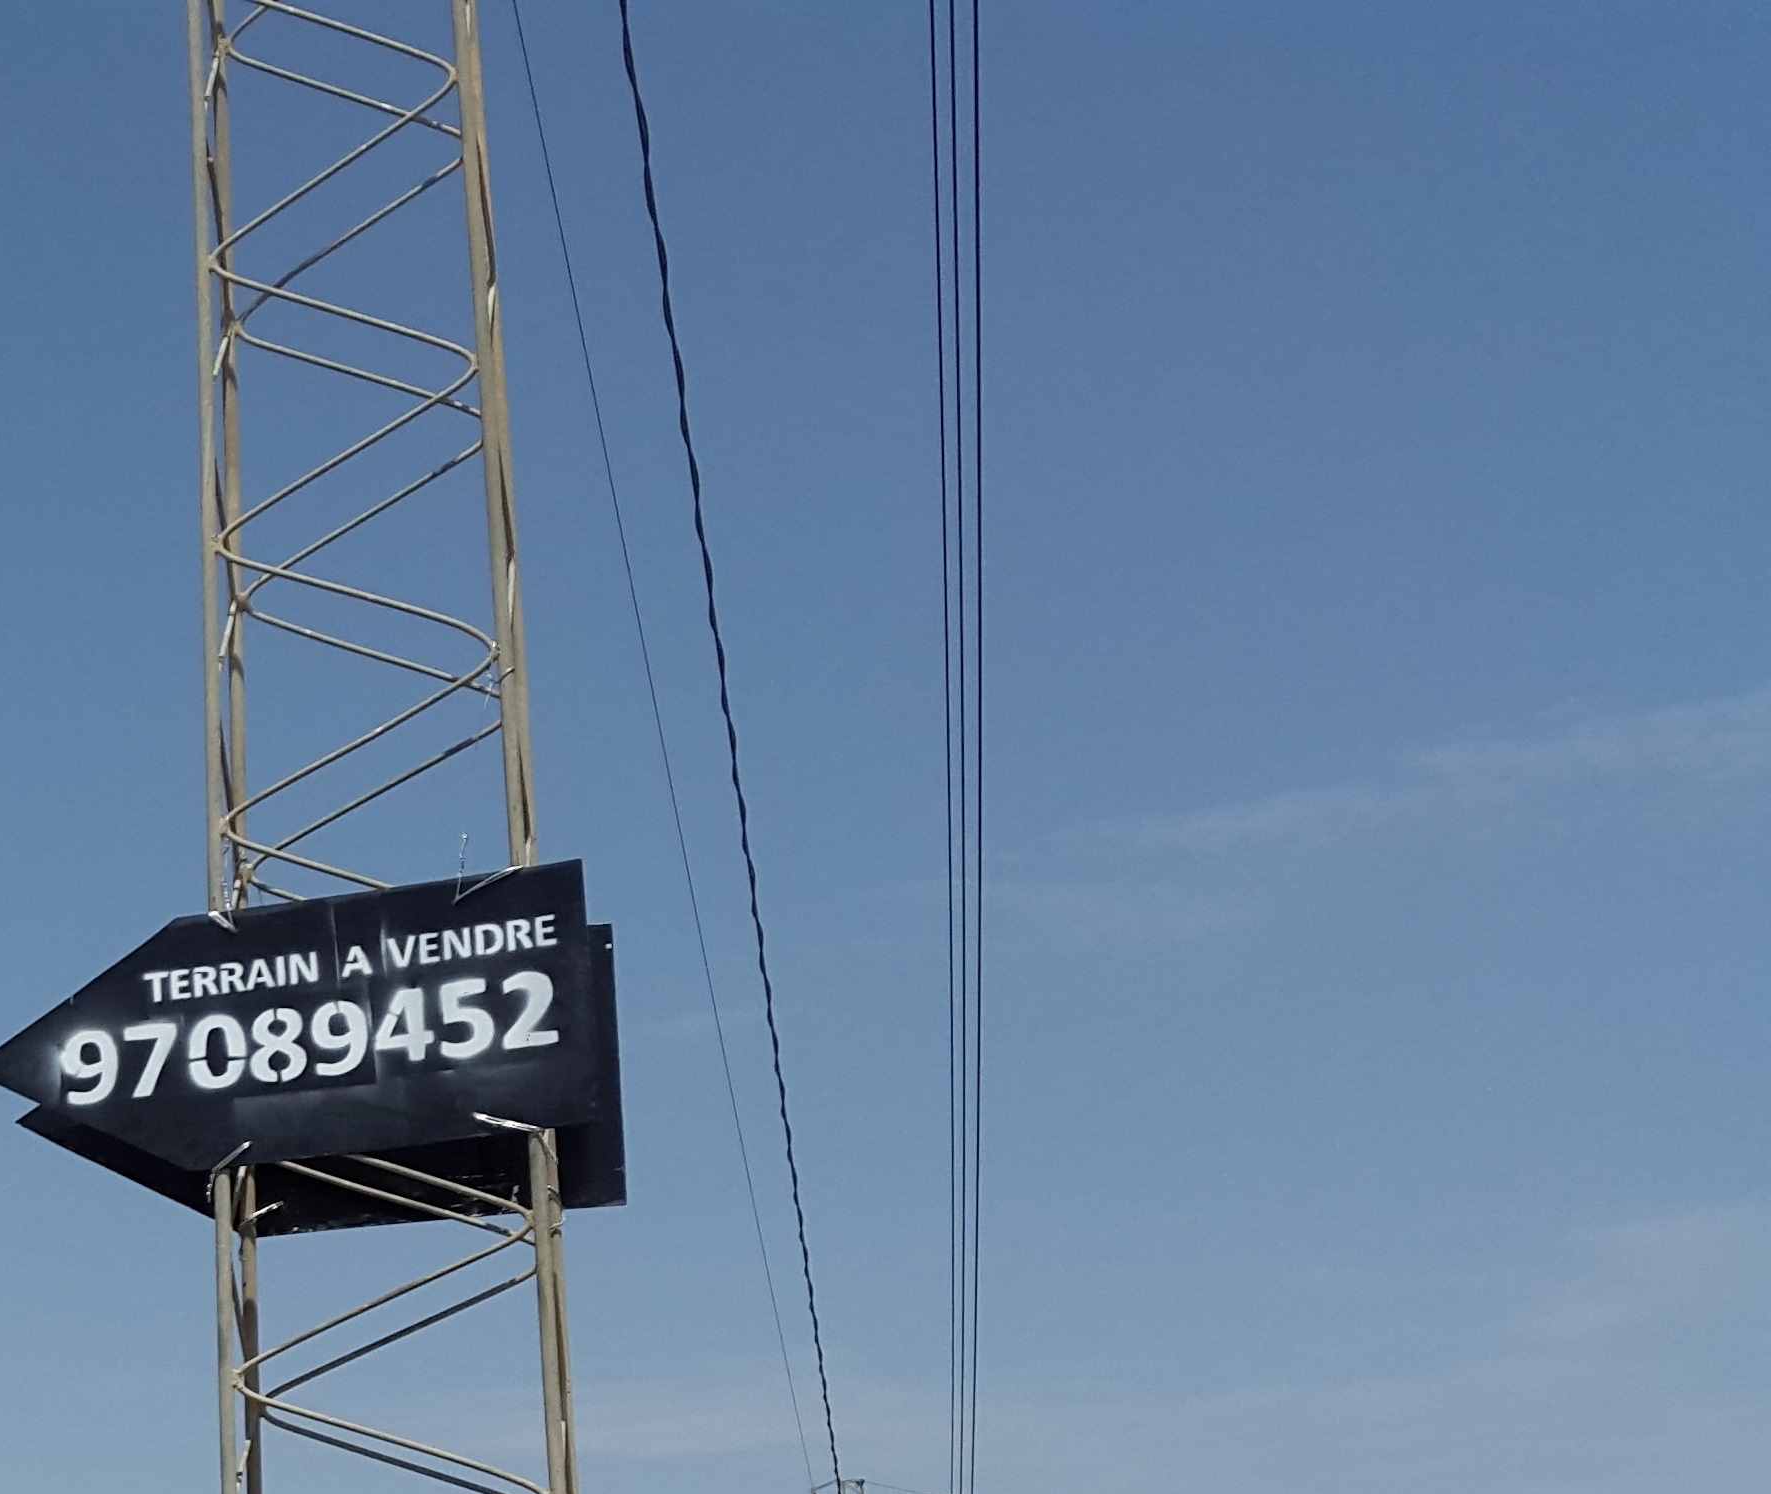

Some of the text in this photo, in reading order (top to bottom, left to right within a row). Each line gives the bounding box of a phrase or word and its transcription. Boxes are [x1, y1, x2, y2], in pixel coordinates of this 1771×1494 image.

[143, 914, 558, 1003] TERRAIN A VENDRE
[60, 970, 559, 1105] 97089452
